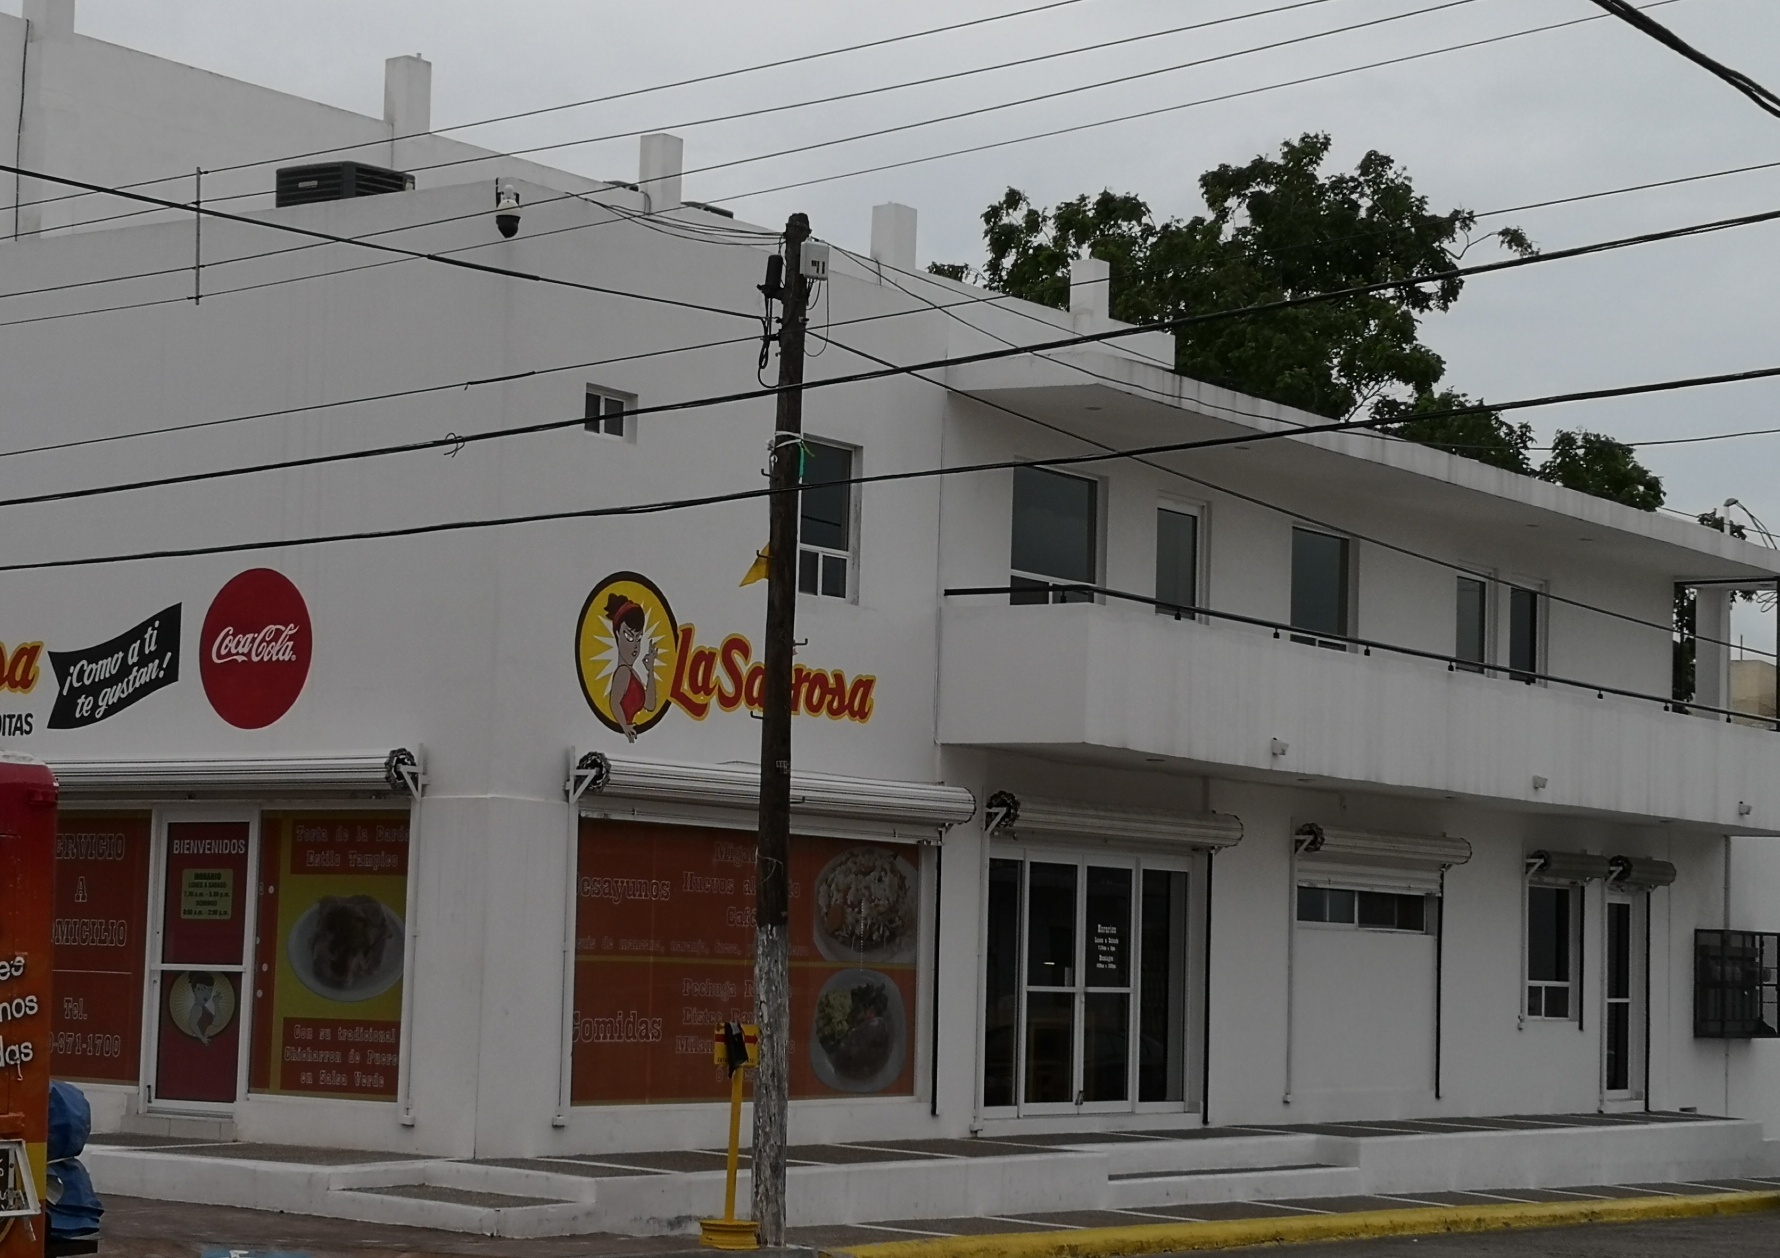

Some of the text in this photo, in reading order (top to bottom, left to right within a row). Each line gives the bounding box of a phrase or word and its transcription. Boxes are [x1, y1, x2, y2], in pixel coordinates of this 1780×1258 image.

[62, 620, 160, 696] ¡Como a ti
[75, 651, 172, 719] te gustan!
[716, 633, 877, 724] Sarosa
[0, 713, 33, 736] ITAS
[335, 825, 349, 842] de
[55, 833, 126, 860] ERVICIO
[173, 839, 246, 854] BIENVENIDOS
[306, 850, 399, 871] Estilo Tampico
[74, 875, 87, 903] A
[578, 875, 671, 905] esayunos
[683, 871, 735, 895] Huevos
[51, 918, 127, 947] MICILIO
[682, 977, 737, 1001] Pechuga
[63, 997, 88, 1020] Tel.
[337, 1026, 396, 1043] tradicional
[348, 1048, 361, 1064] de
[319, 1069, 348, 1086] Salsa
[354, 1071, 385, 1088] Verde
